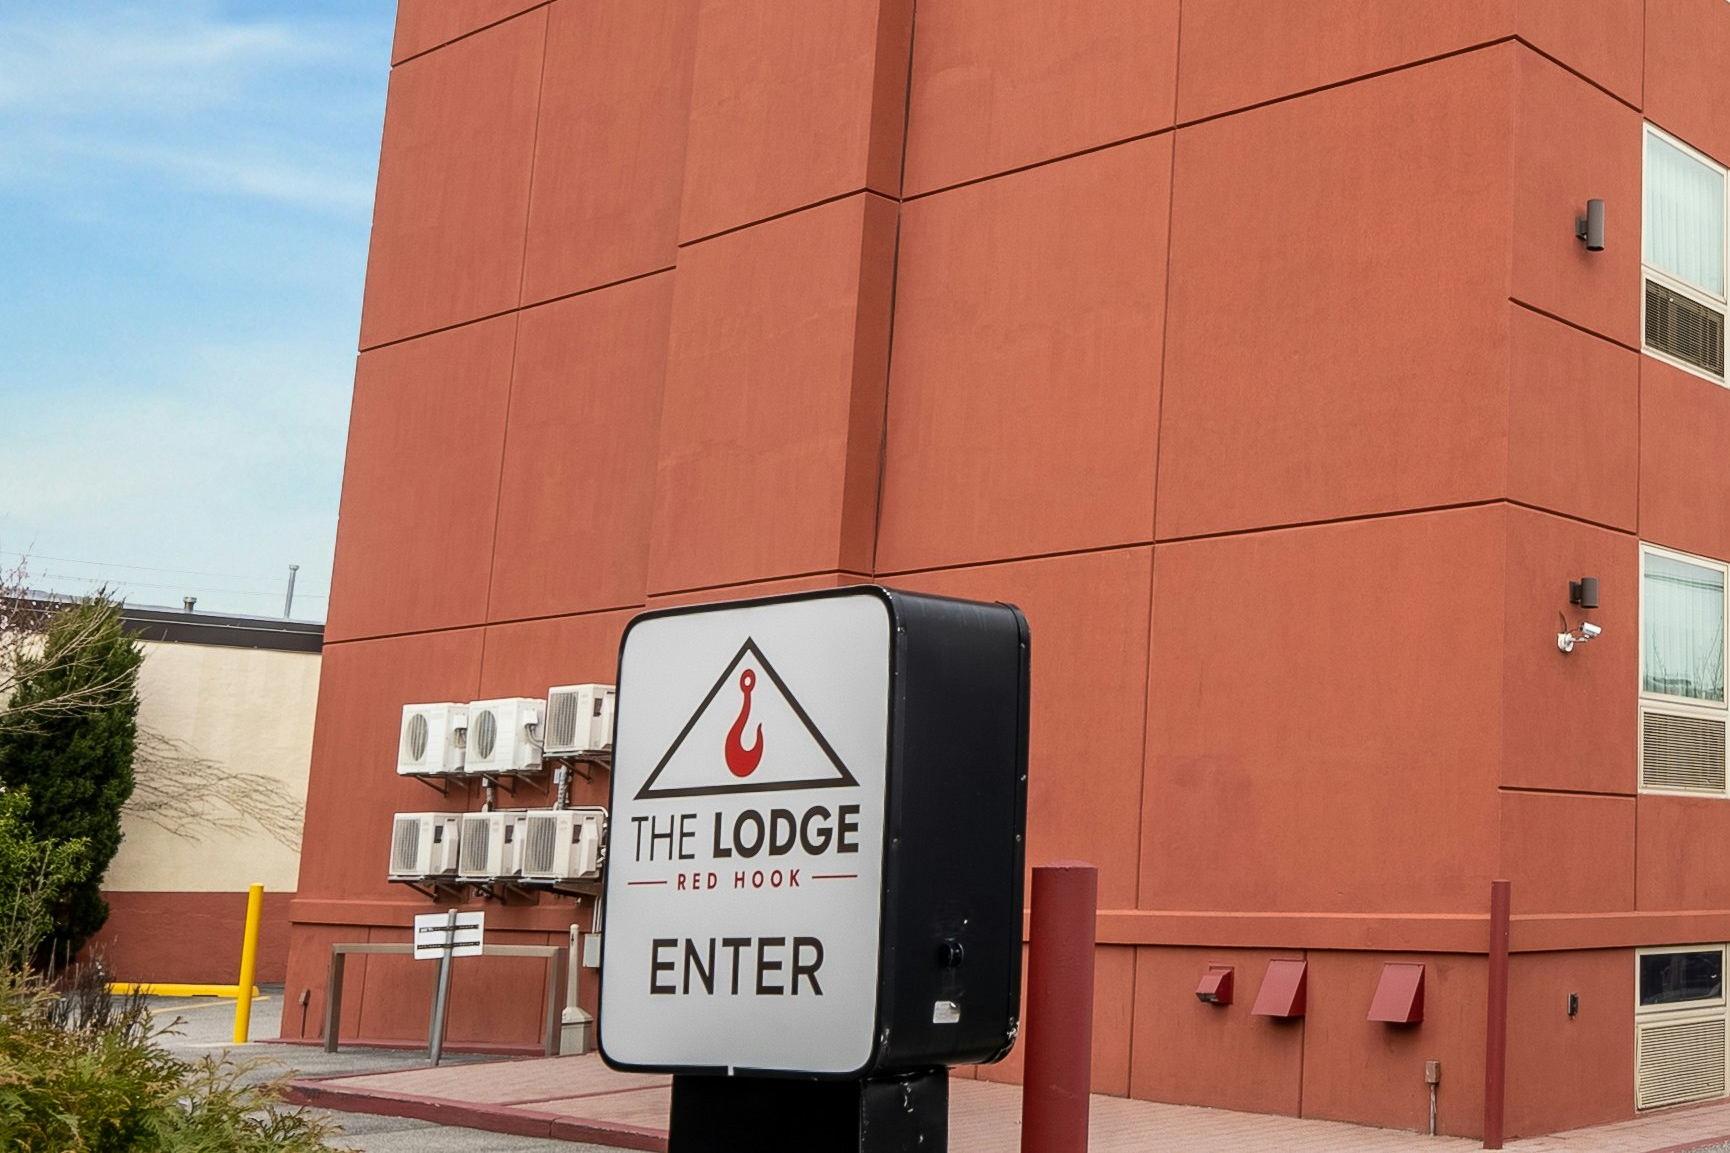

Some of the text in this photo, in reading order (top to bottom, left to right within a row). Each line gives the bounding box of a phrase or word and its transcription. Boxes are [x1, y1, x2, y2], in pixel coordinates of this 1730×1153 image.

[631, 804, 860, 861] THE LODGE
[677, 869, 800, 891] RED HOOK
[650, 937, 824, 996] ENTER
